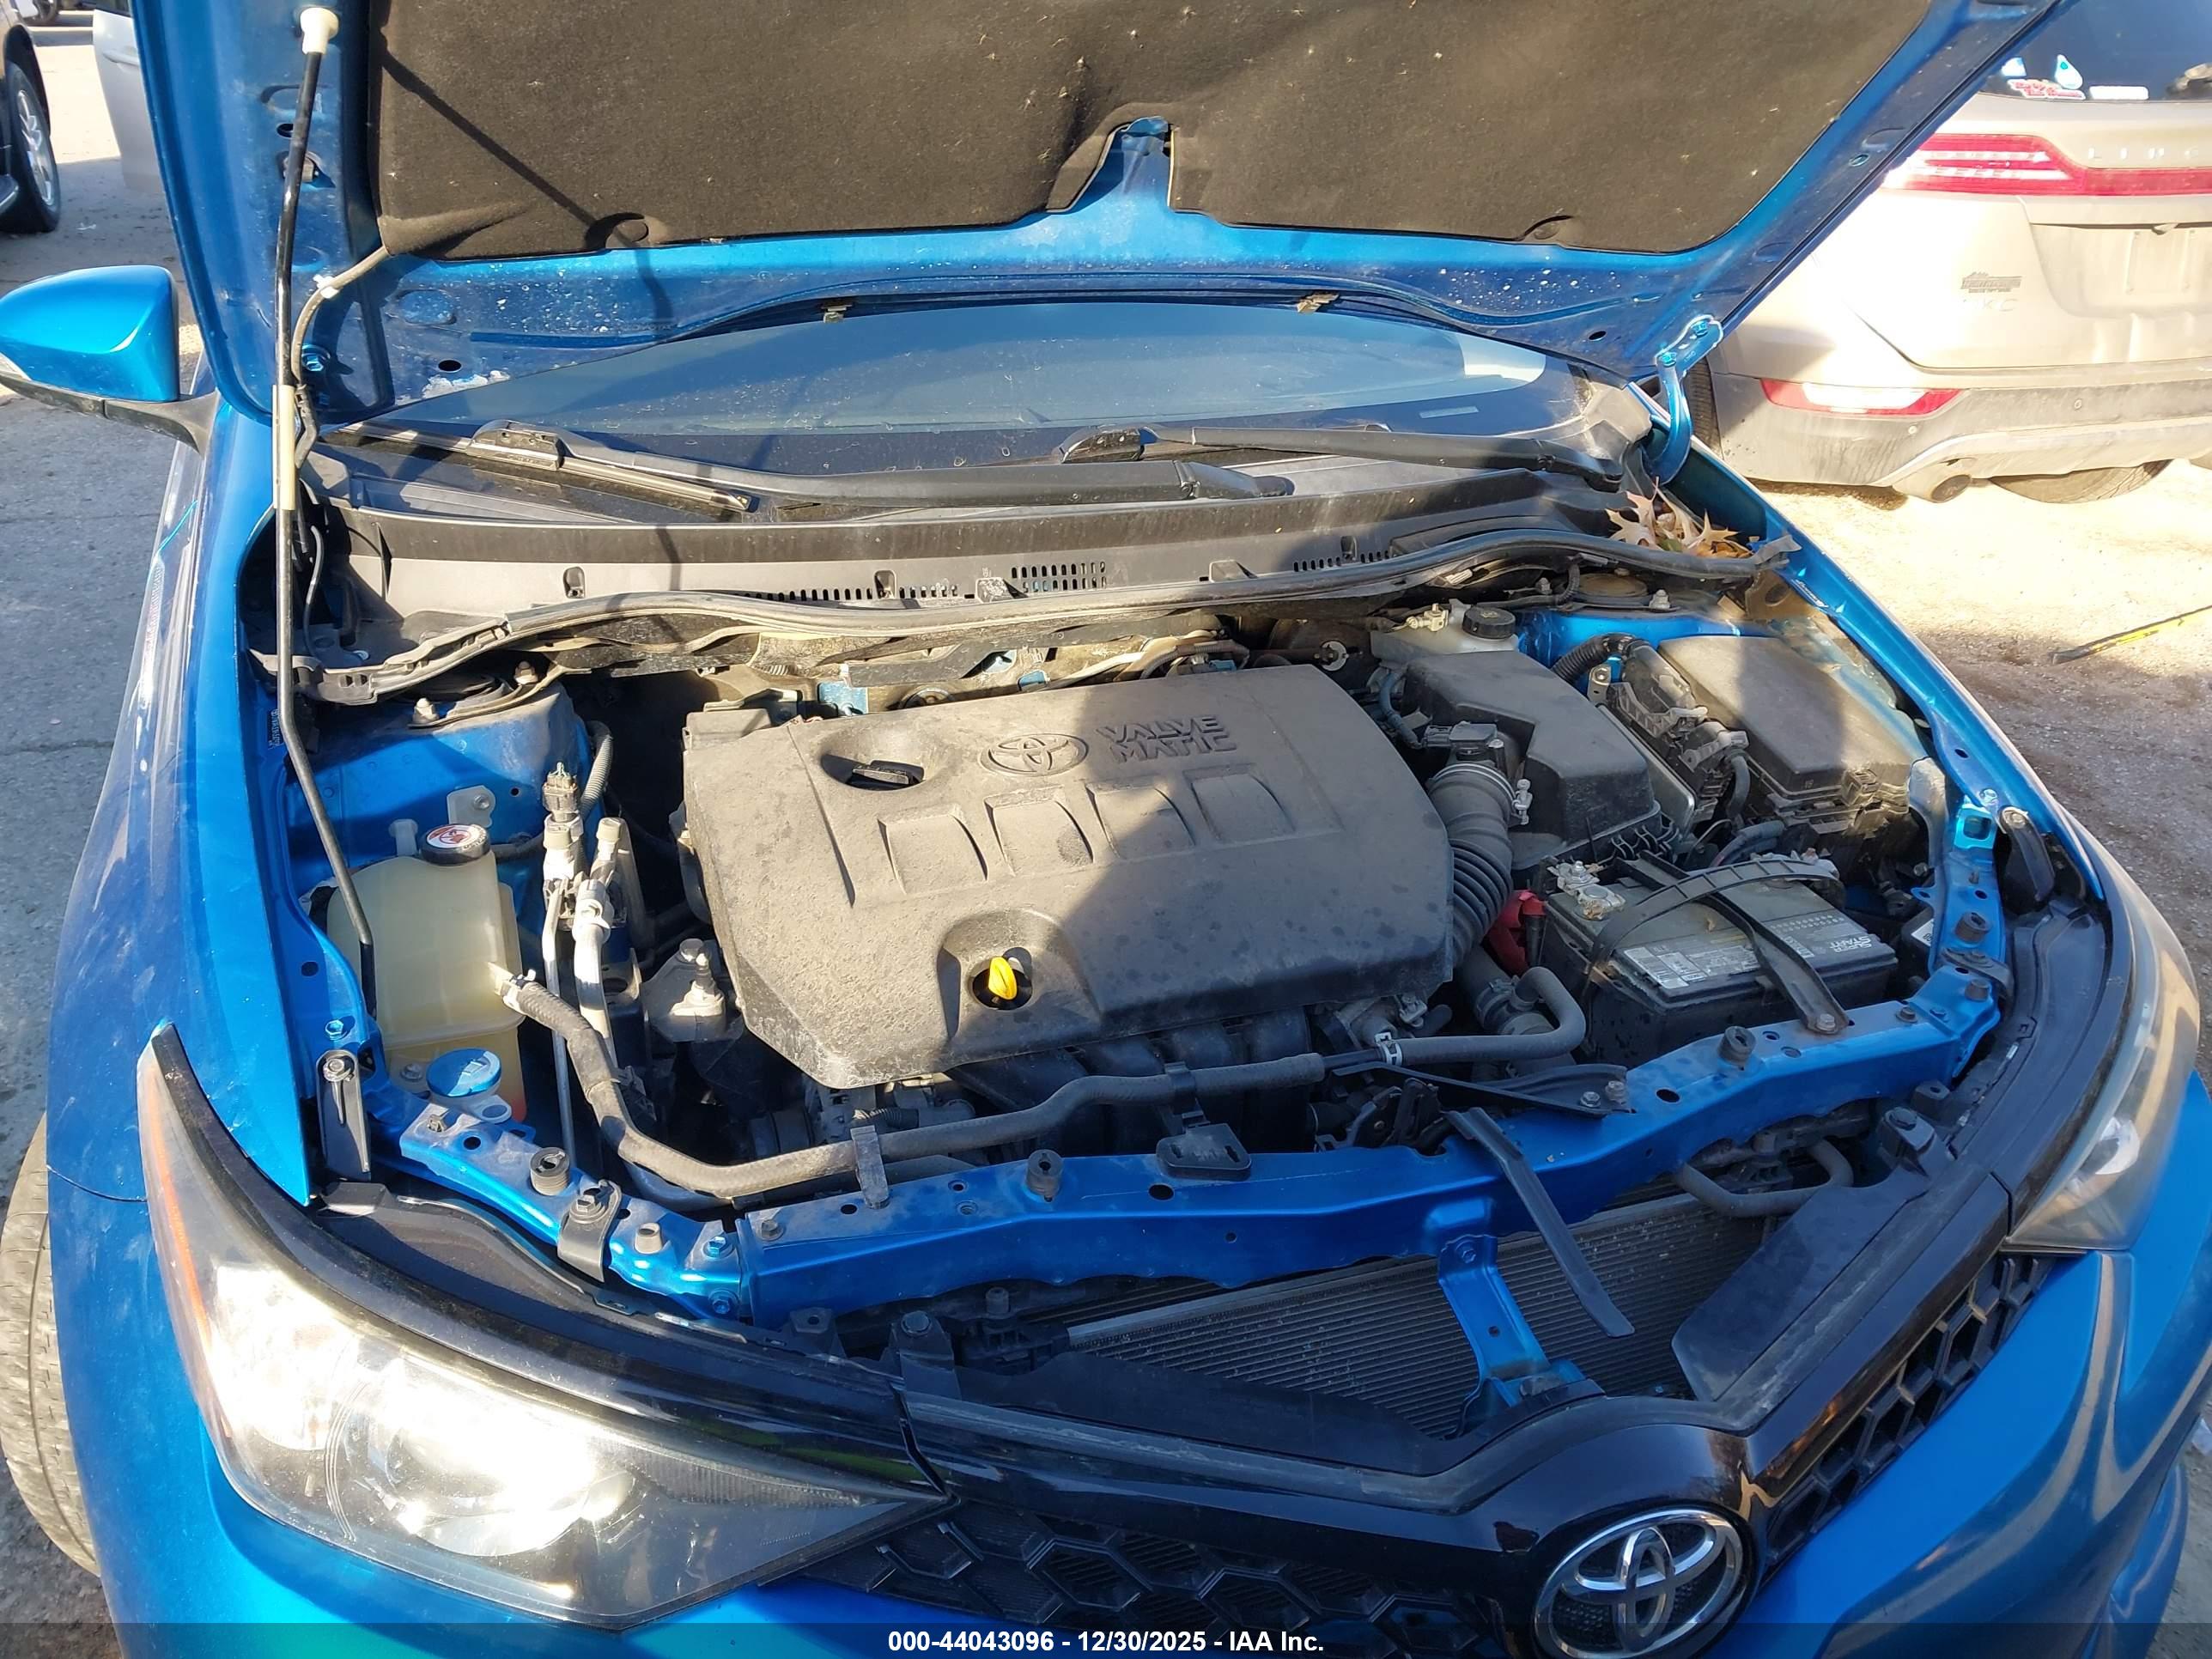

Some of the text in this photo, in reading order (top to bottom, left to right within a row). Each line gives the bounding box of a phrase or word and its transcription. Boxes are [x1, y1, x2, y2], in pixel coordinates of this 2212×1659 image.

[1096, 715, 1224, 743] VALVE
[1108, 734, 1237, 764] MATIC
[1829, 935, 1872, 949] START
